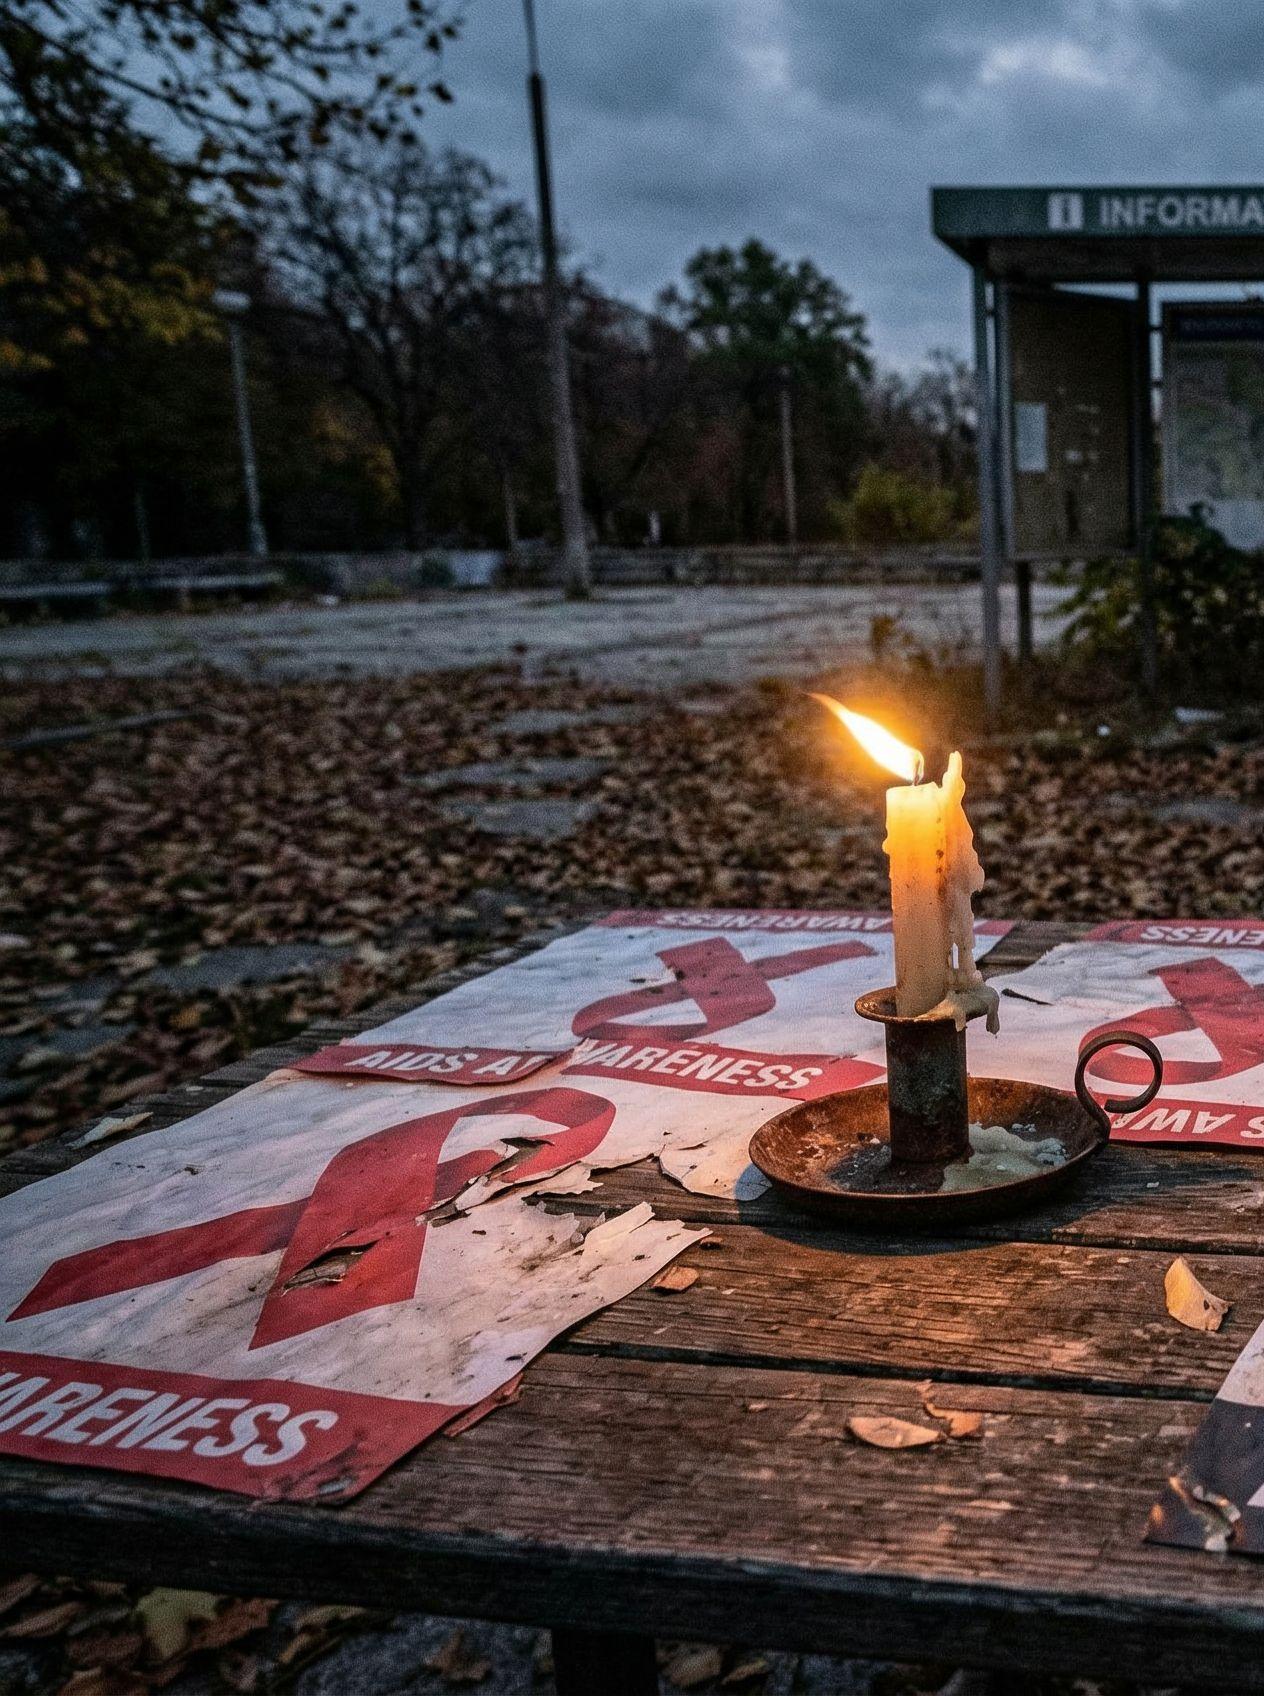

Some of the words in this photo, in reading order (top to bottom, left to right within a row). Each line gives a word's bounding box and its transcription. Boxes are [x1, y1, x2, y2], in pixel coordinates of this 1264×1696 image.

[656, 912, 892, 931] AWARENESS
[344, 1049, 479, 1074] AIDS
[0, 1371, 340, 1466] ARENESS
